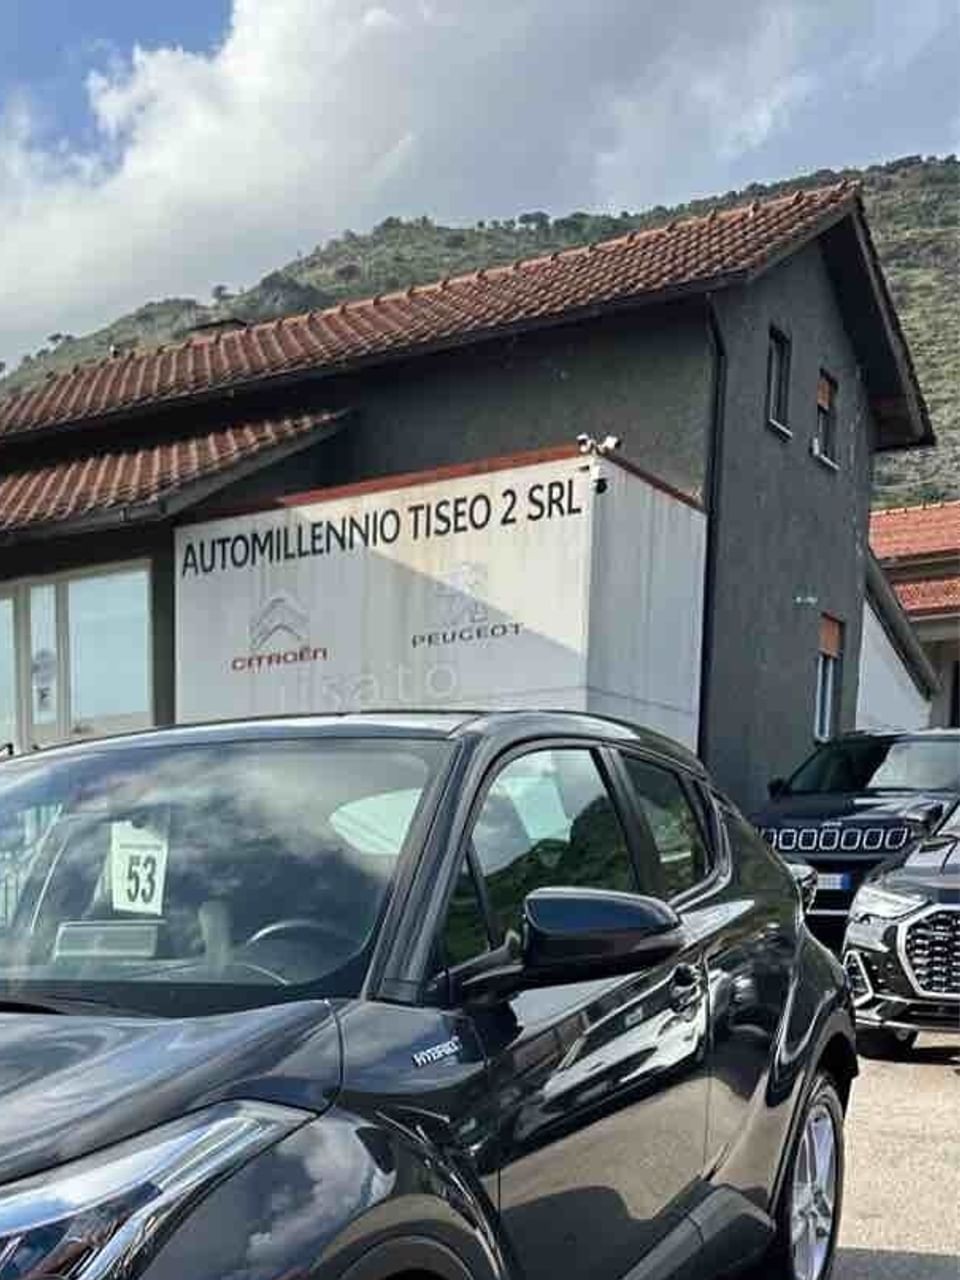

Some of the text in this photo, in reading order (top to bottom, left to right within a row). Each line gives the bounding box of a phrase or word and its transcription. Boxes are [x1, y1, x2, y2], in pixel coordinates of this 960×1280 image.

[181, 478, 583, 577] AUTOMILLENNIO TISEO 2 SRL
[411, 621, 525, 649] PEUGEOT
[126, 856, 157, 904] 53
